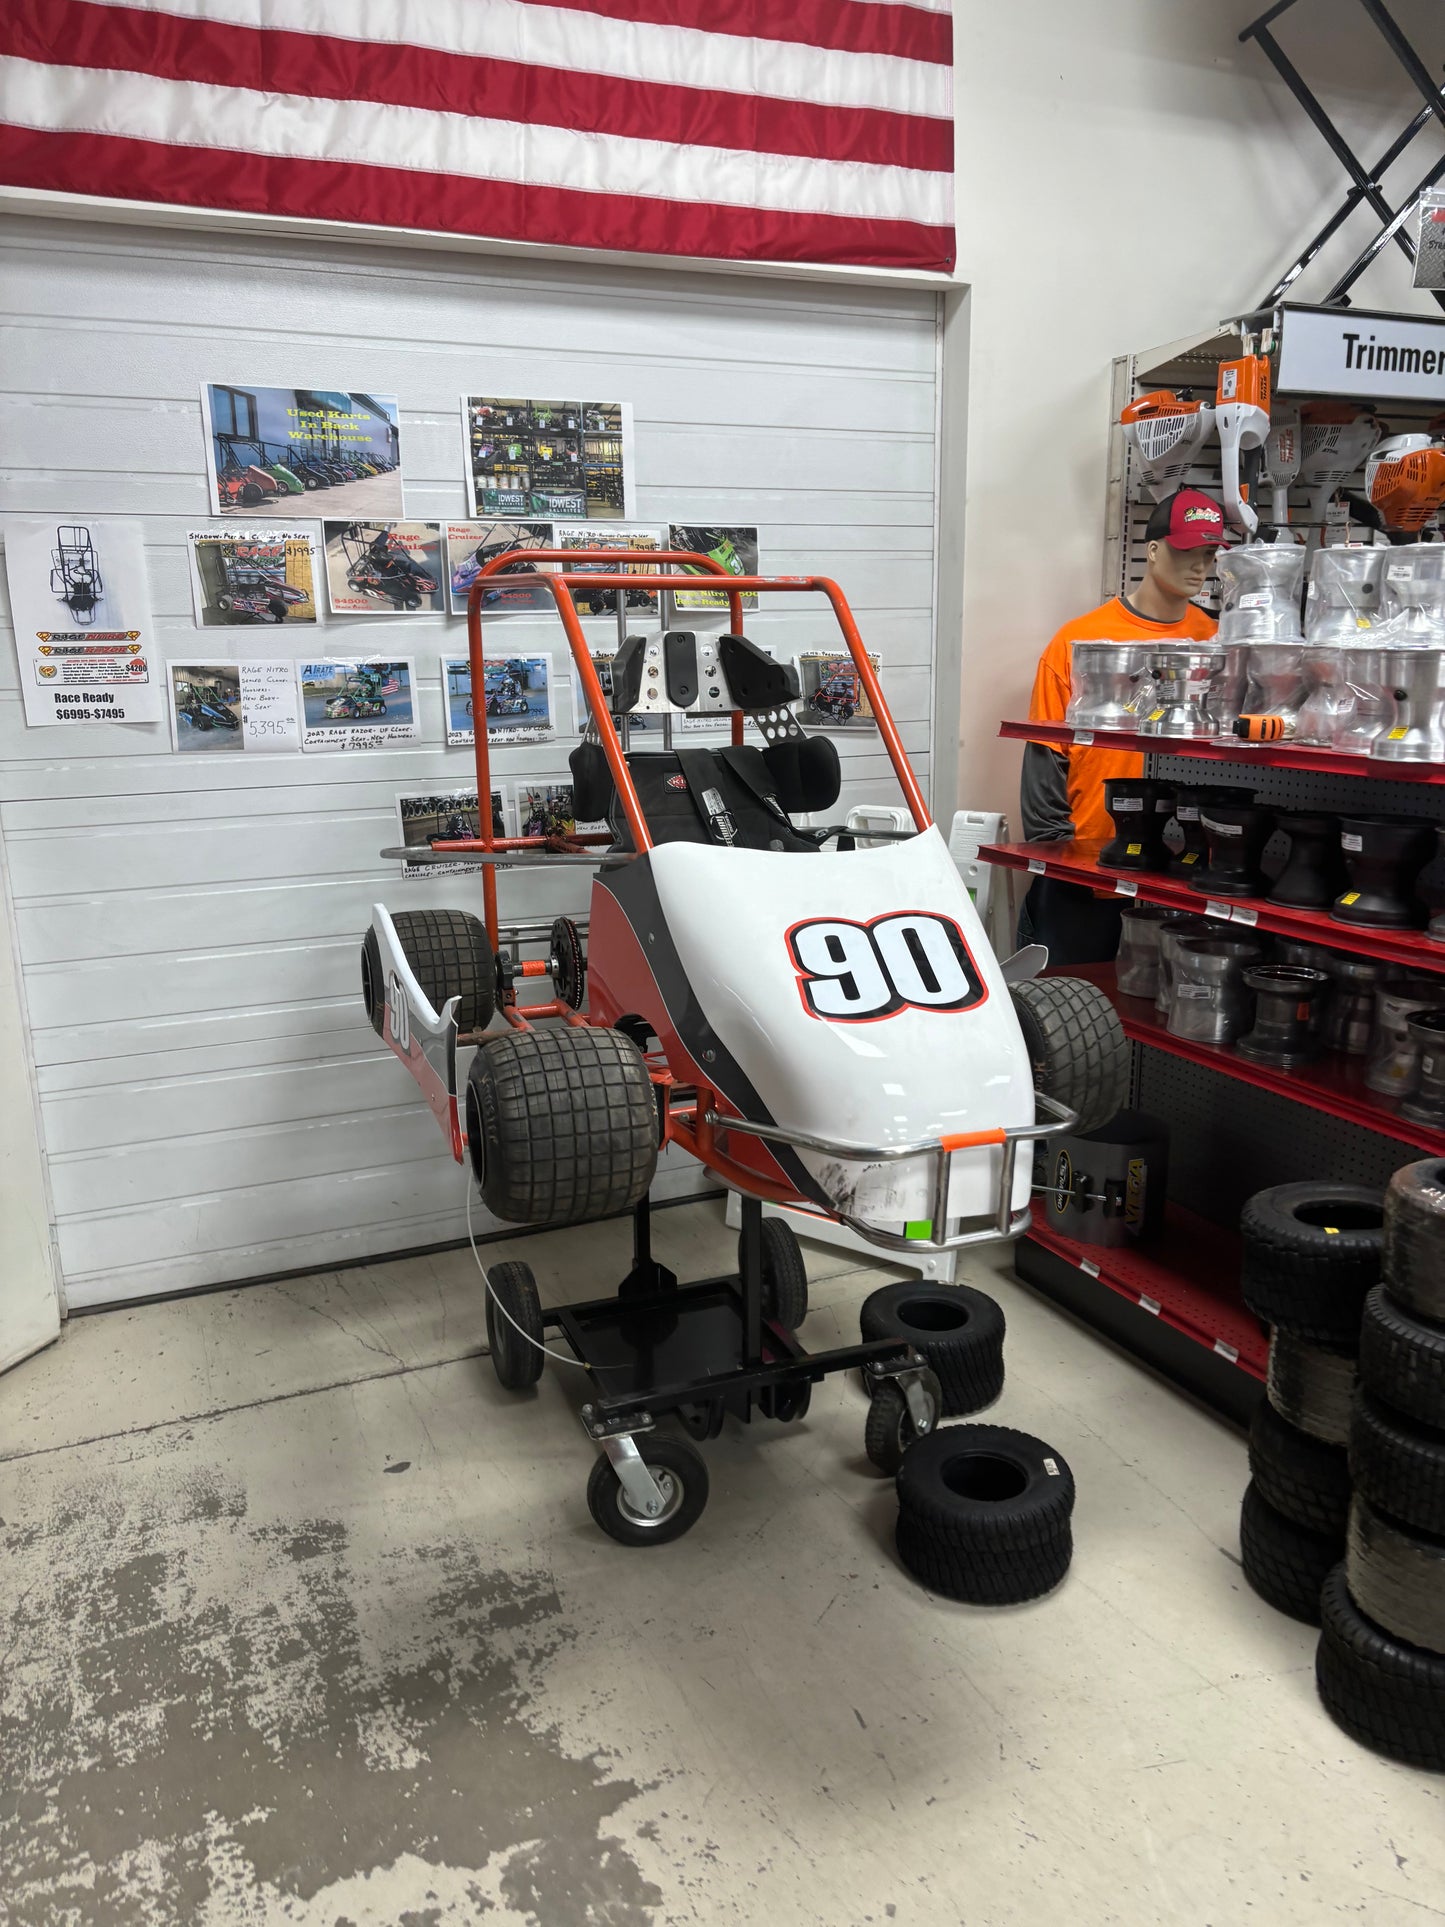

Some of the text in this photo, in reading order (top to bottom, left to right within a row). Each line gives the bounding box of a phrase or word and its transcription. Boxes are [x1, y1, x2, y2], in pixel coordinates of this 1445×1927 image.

[286, 408, 371, 421] Used Karts
[299, 420, 359, 431] In Back
[288, 431, 373, 443] Warehouse
[1286, 428, 1294, 463] STIHL
[388, 533, 420, 541] Rage
[286, 547, 316, 557] $1995
[125, 664, 147, 673] $4200
[242, 666, 262, 674] RAGE
[54, 692, 114, 704] Race Ready
[56, 708, 125, 720] $6995-$7495
[785, 912, 987, 1021] 90
